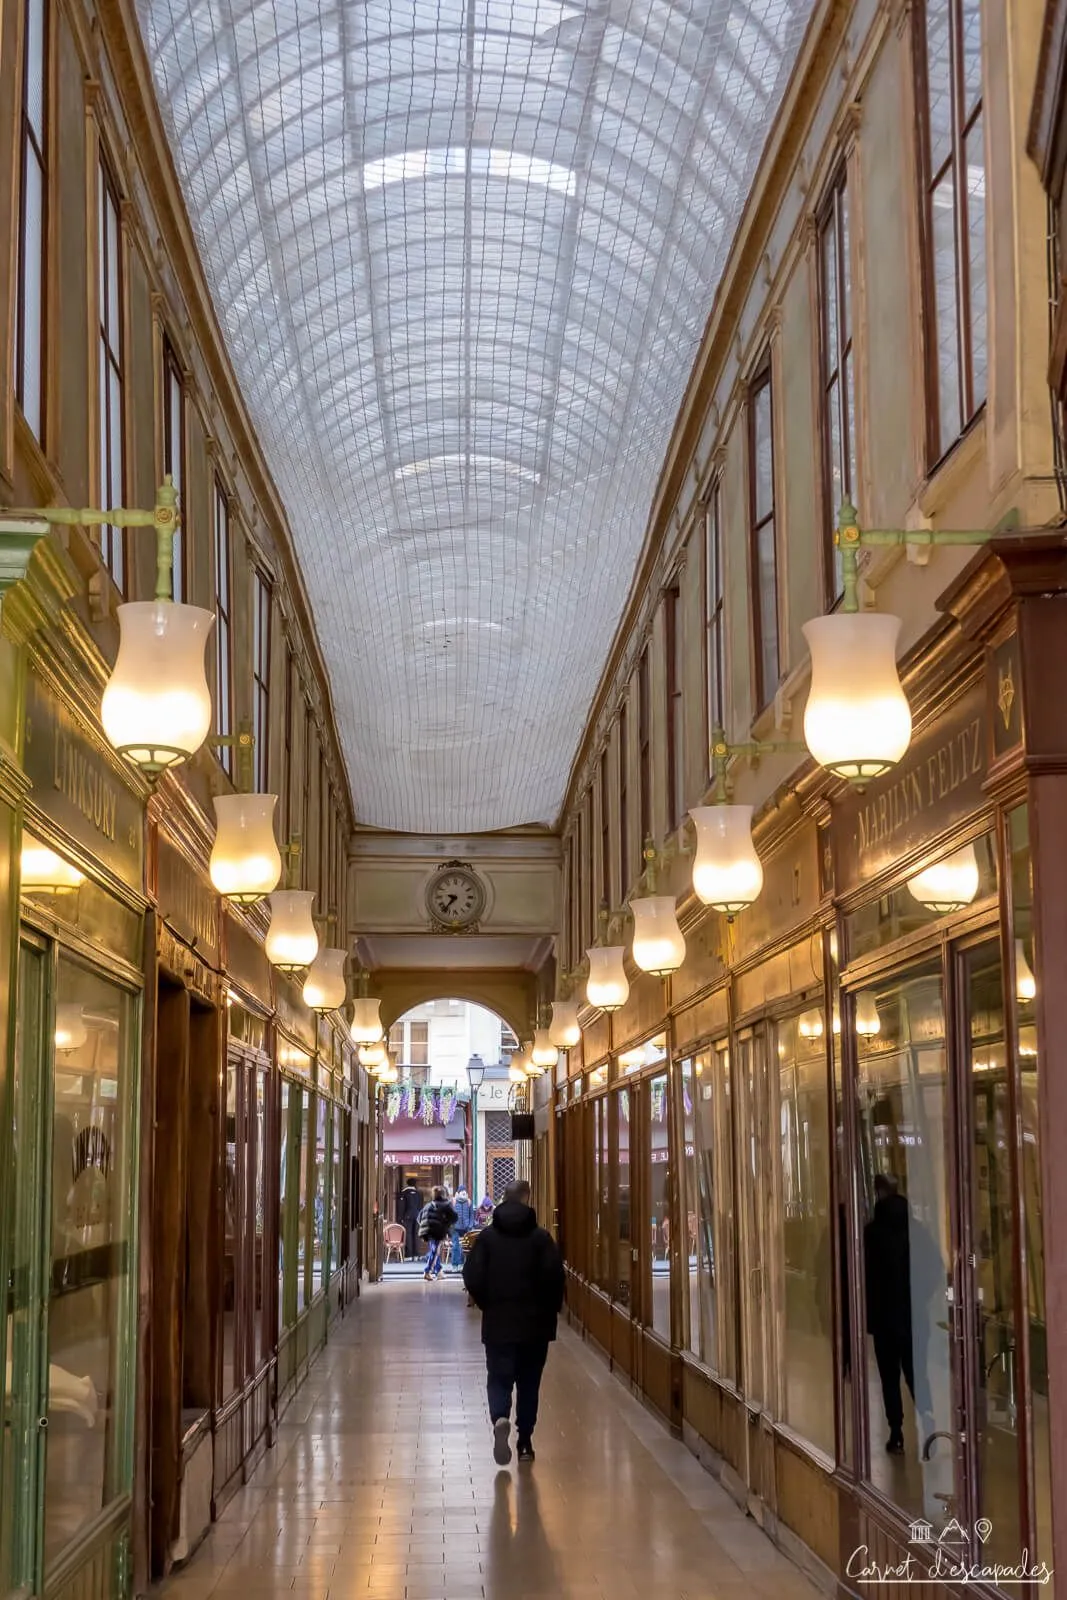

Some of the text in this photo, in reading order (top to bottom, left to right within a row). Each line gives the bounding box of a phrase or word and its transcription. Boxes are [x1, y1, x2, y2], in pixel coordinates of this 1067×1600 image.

[857, 717, 981, 857] MARILYN FELTZ
[383, 1153, 399, 1164] AL
